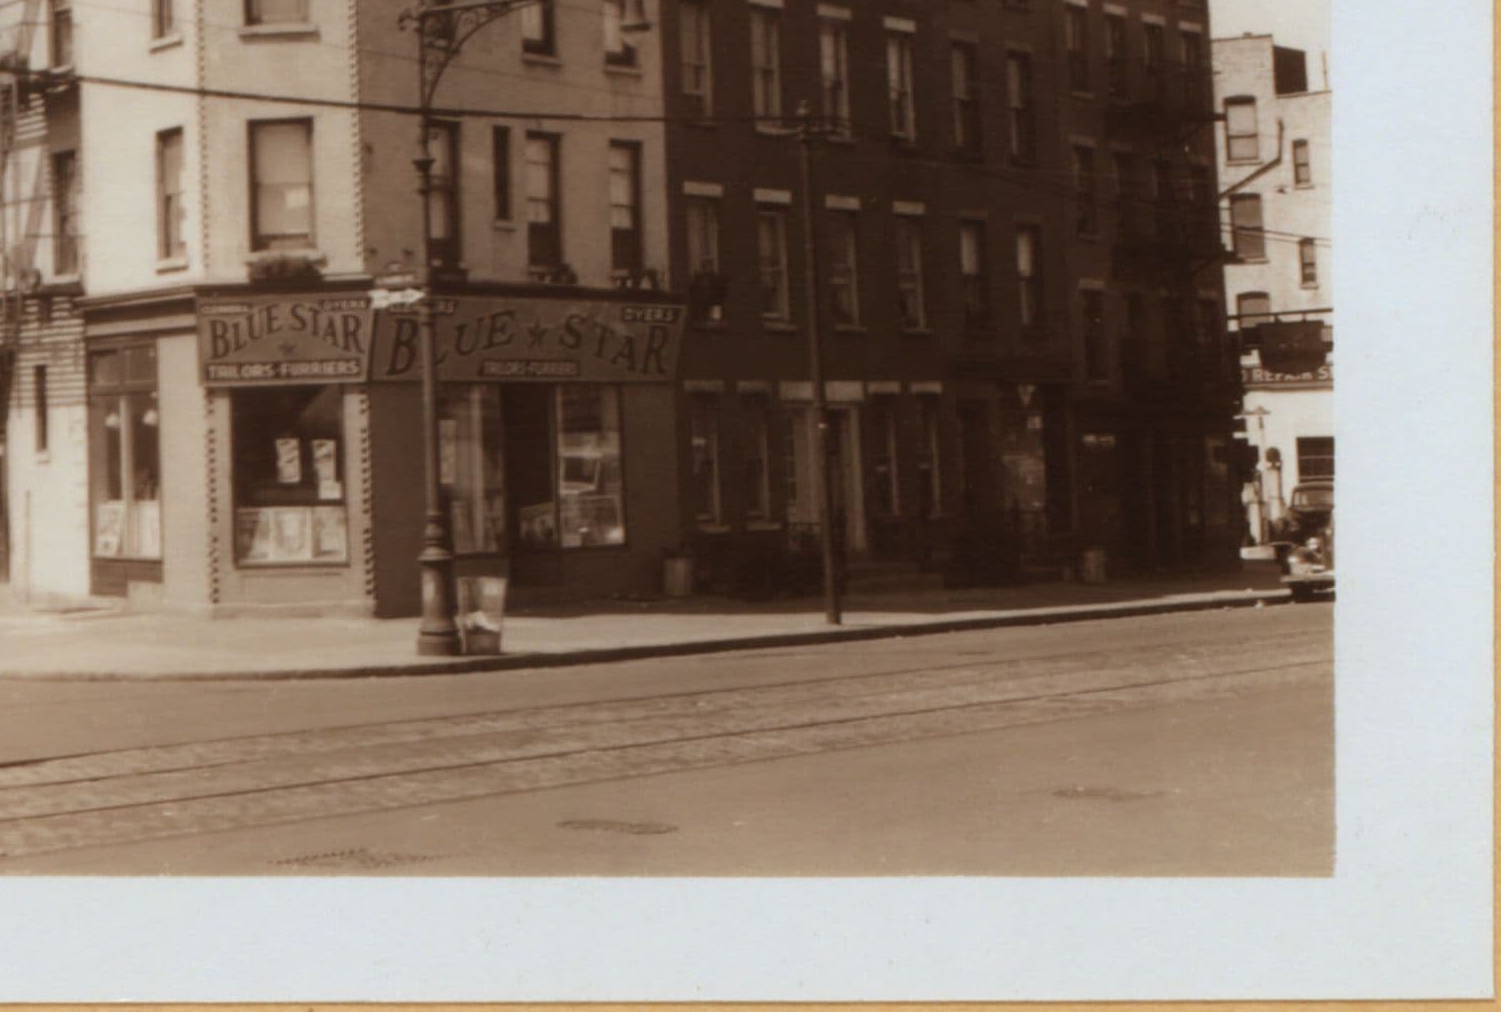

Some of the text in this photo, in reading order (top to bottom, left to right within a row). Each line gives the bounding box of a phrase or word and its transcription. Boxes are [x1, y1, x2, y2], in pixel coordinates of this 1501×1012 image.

[209, 303, 365, 359] BLUE STAR
[623, 308, 675, 322] DYERS
[560, 314, 668, 374] STAR
